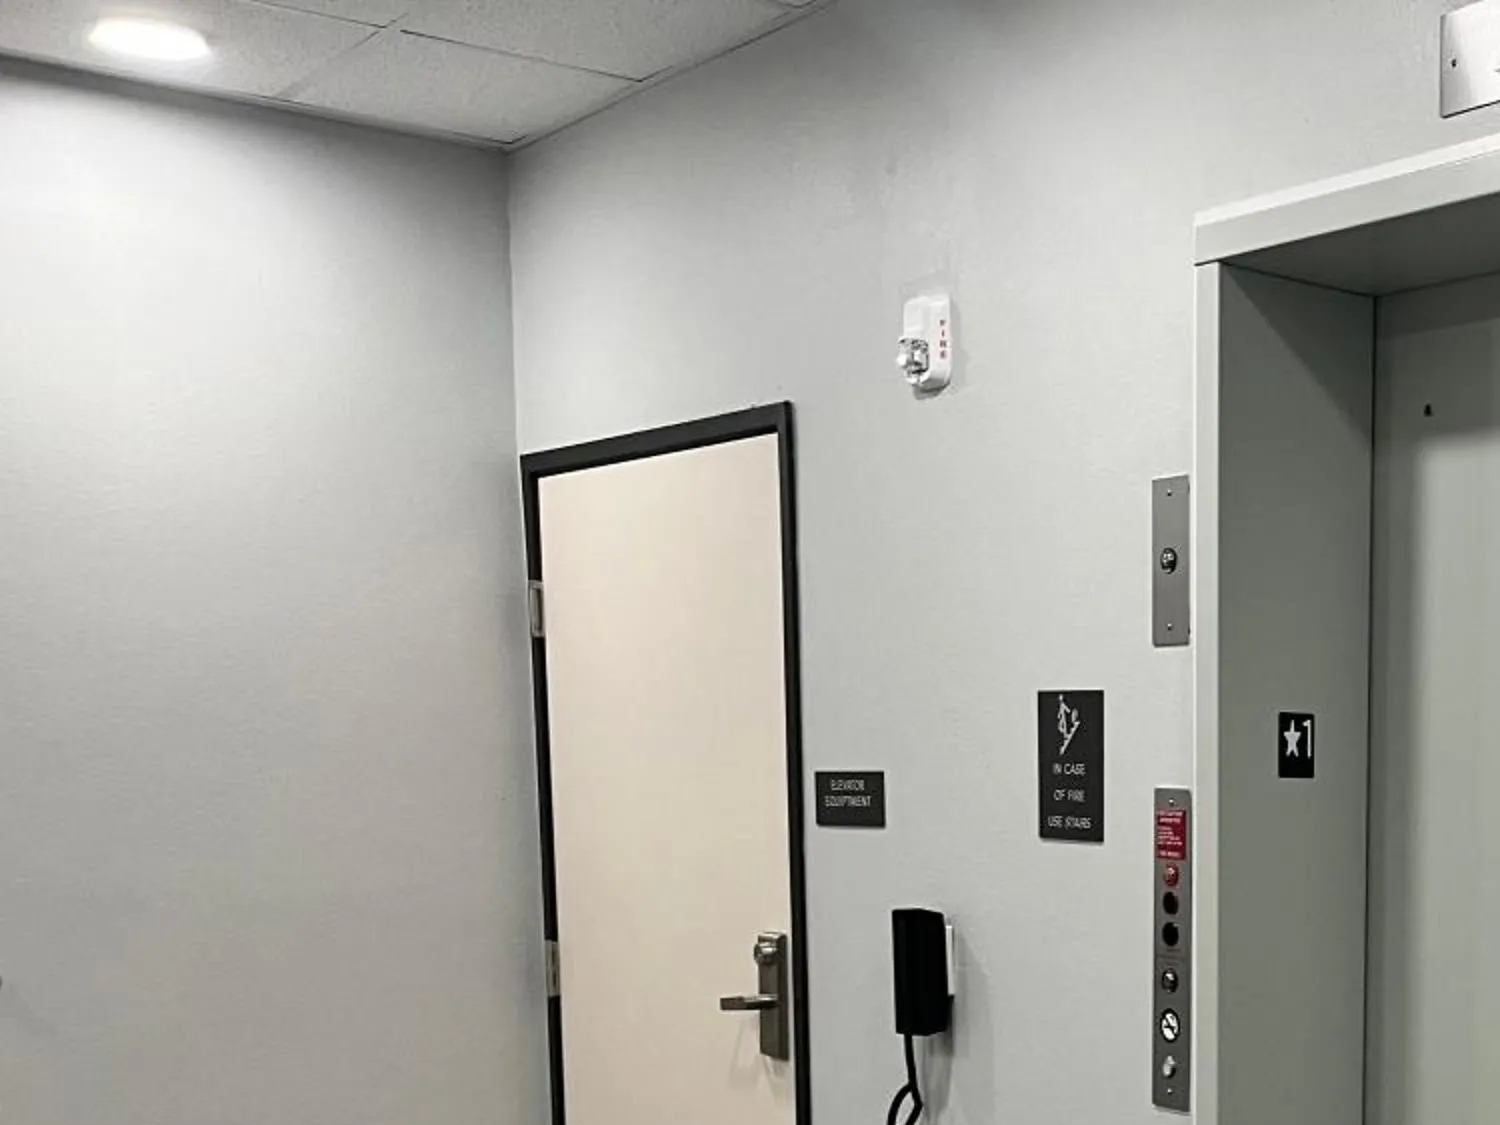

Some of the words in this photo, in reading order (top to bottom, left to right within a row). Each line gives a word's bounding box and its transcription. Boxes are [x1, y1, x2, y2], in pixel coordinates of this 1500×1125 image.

[939, 319, 947, 359] FIRE
[1302, 719, 1312, 759] 1
[1053, 763, 1062, 775] IN
[1063, 763, 1087, 776] CASE
[831, 779, 865, 791] ELEVATOR
[1053, 789, 1065, 802] OF
[1067, 790, 1086, 803] FIRE
[1048, 816, 1063, 828] USE
[1065, 817, 1092, 830] STAIRS
